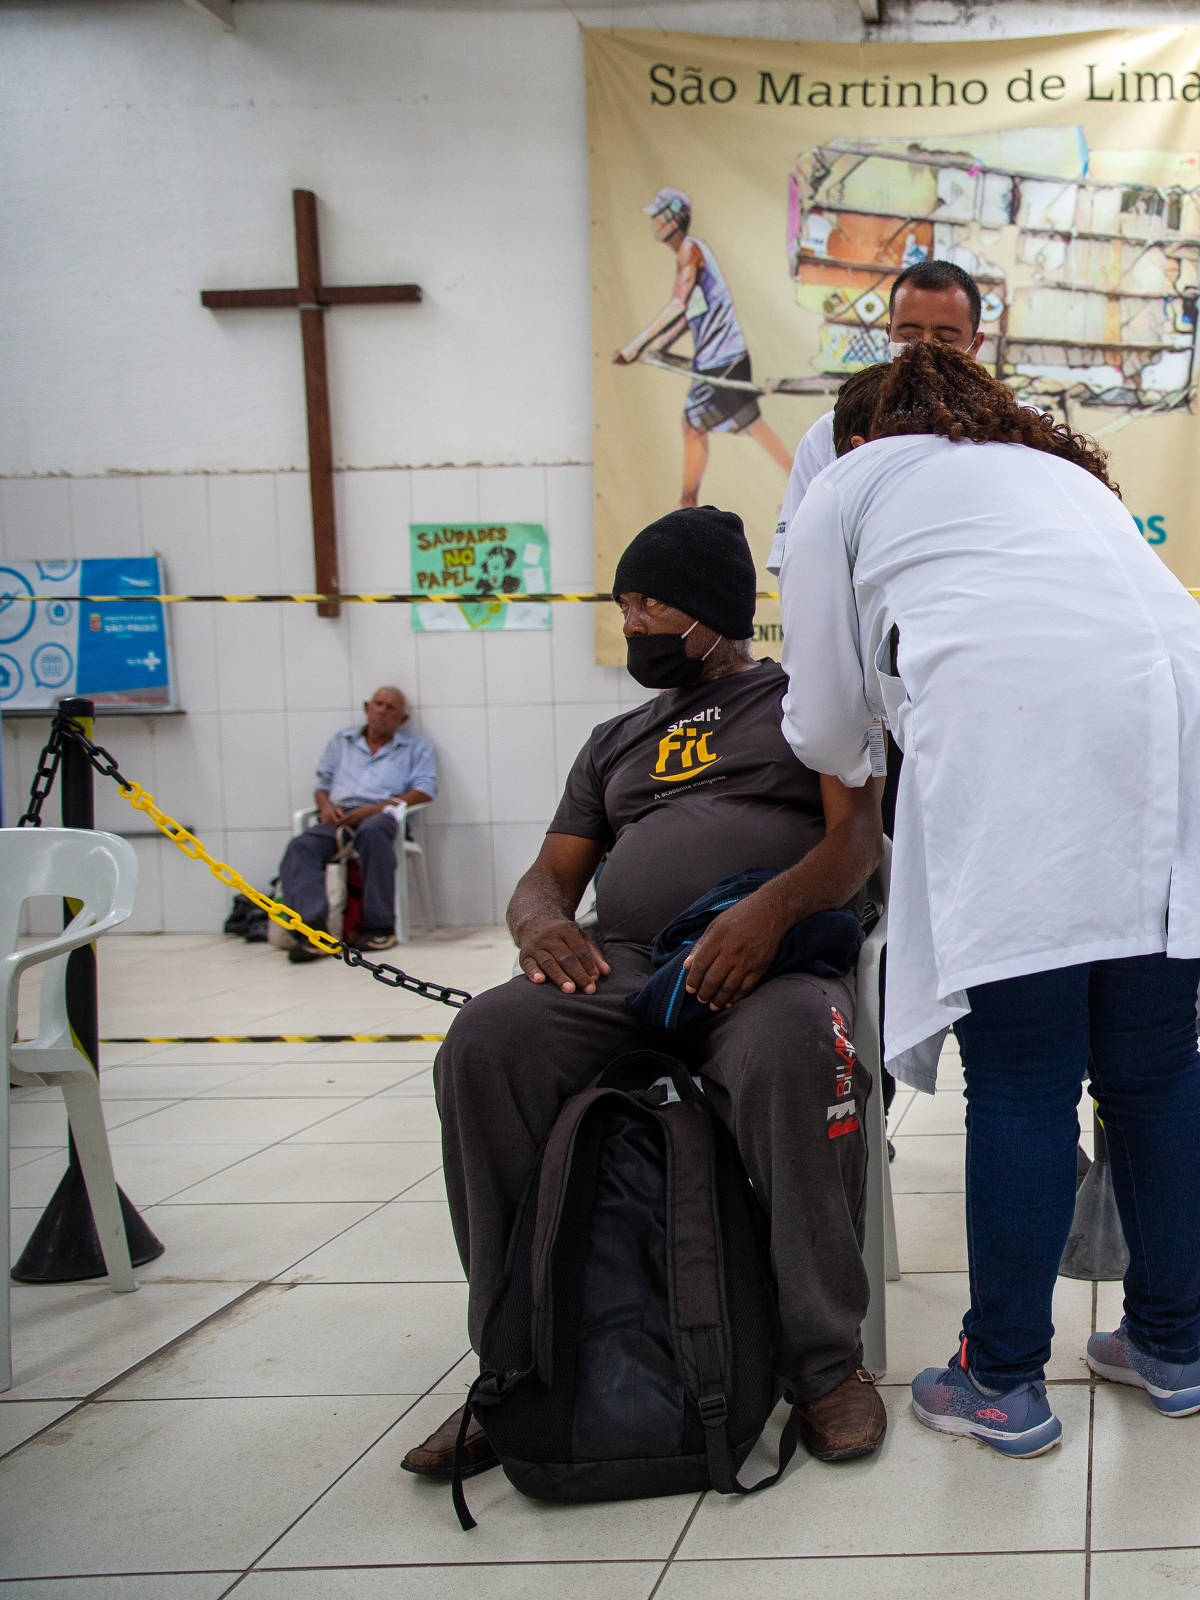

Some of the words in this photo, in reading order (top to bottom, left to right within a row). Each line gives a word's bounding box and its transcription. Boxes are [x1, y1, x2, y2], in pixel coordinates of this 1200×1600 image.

[649, 63, 737, 106] São
[756, 70, 988, 108] Martinho
[1007, 68, 1066, 102] de
[444, 548, 475, 568] NO
[416, 565, 476, 590] PAPEL
